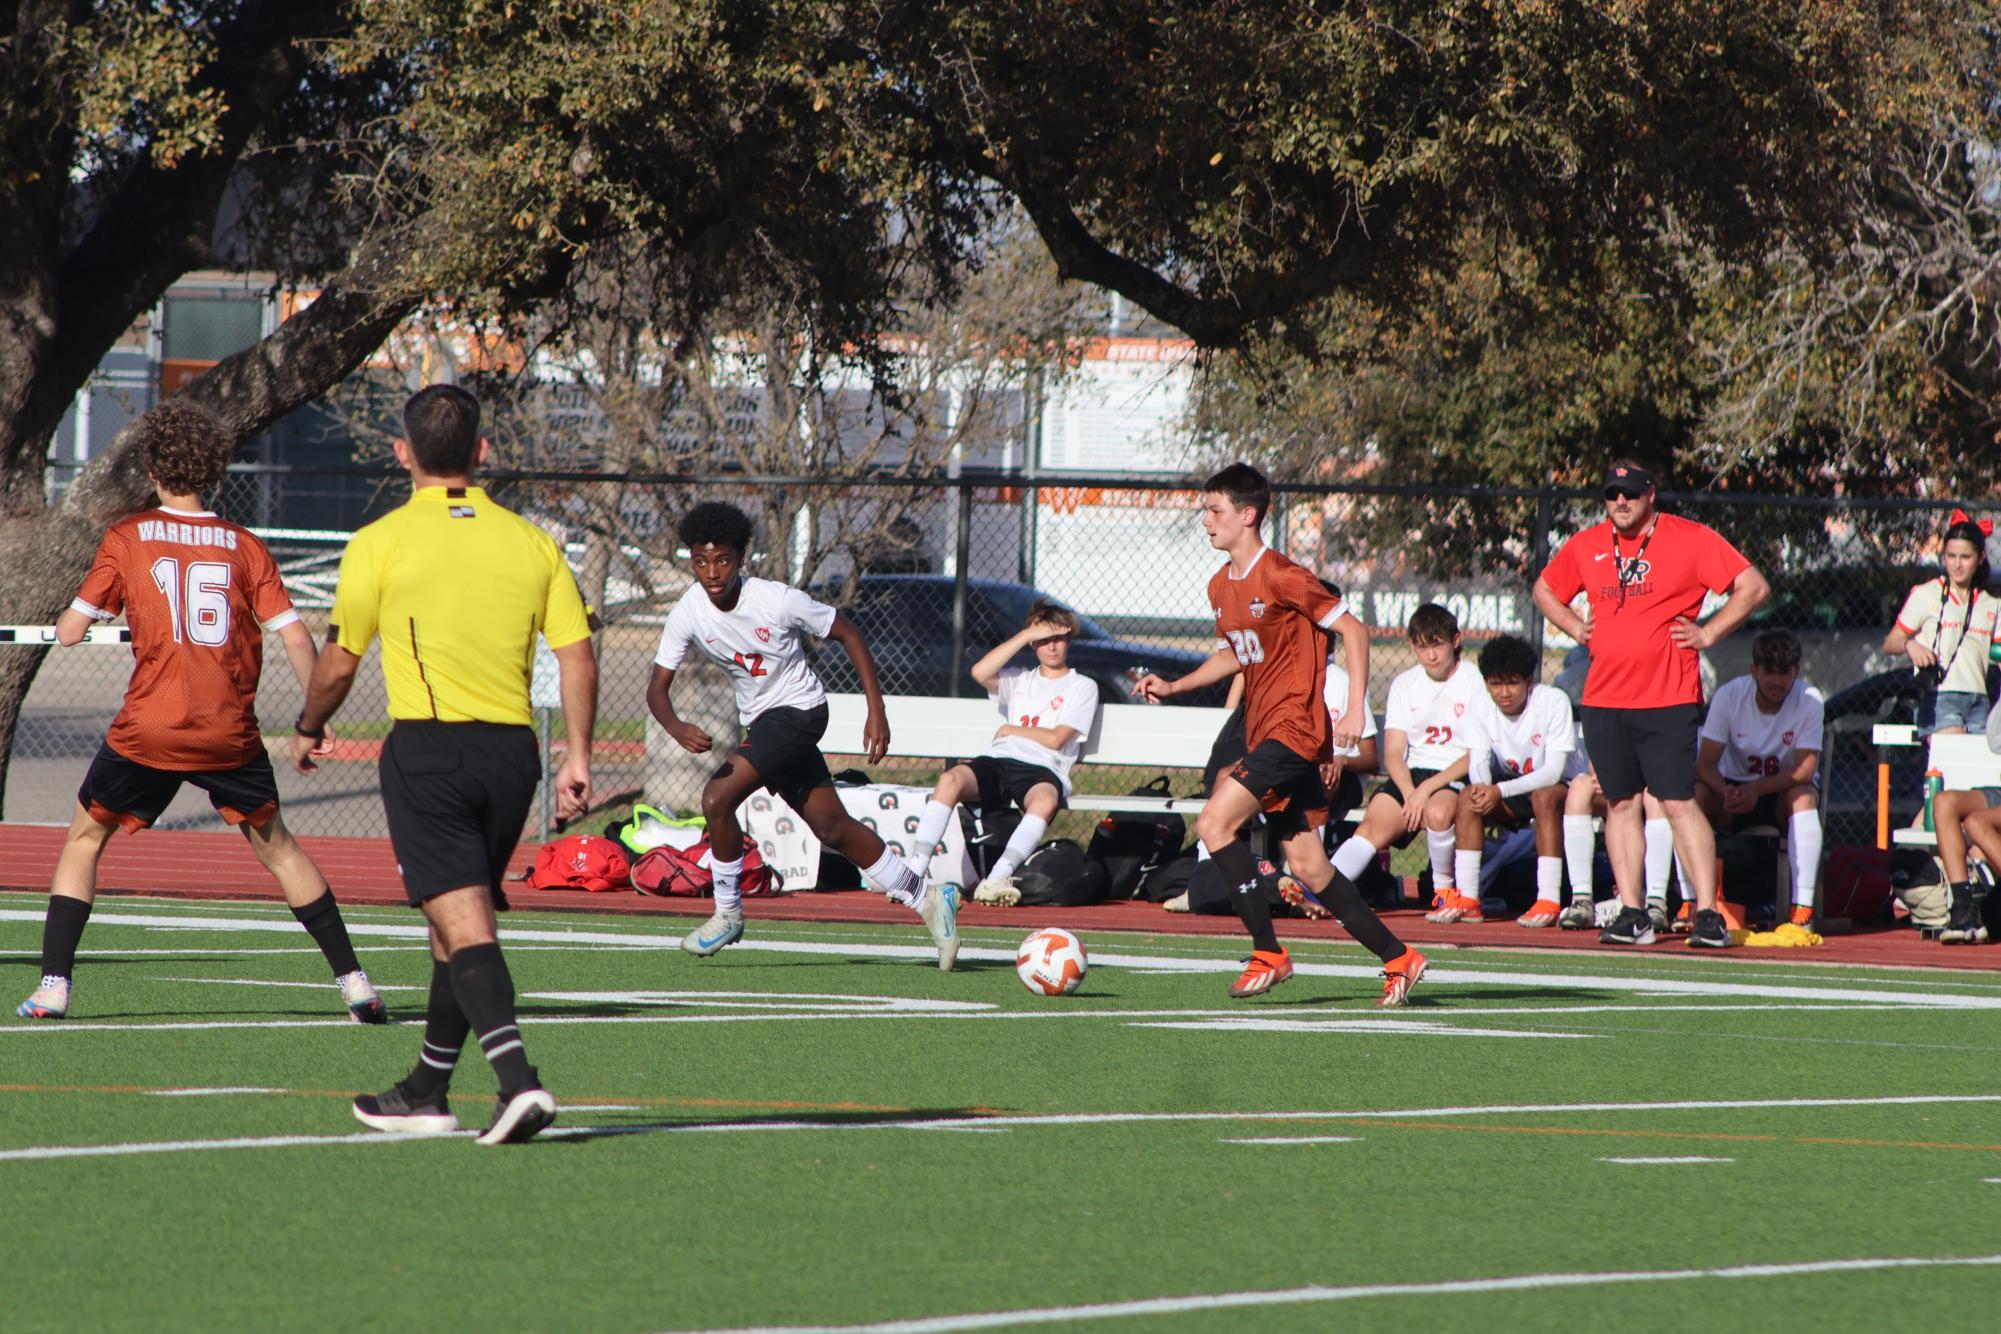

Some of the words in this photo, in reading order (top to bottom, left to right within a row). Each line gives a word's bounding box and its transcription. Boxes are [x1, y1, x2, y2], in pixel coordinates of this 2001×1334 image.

[137, 520, 237, 550] WARRIORS
[150, 556, 231, 647] 16
[1601, 583, 1654, 599] FOOBALL
[1226, 629, 1264, 665] 20
